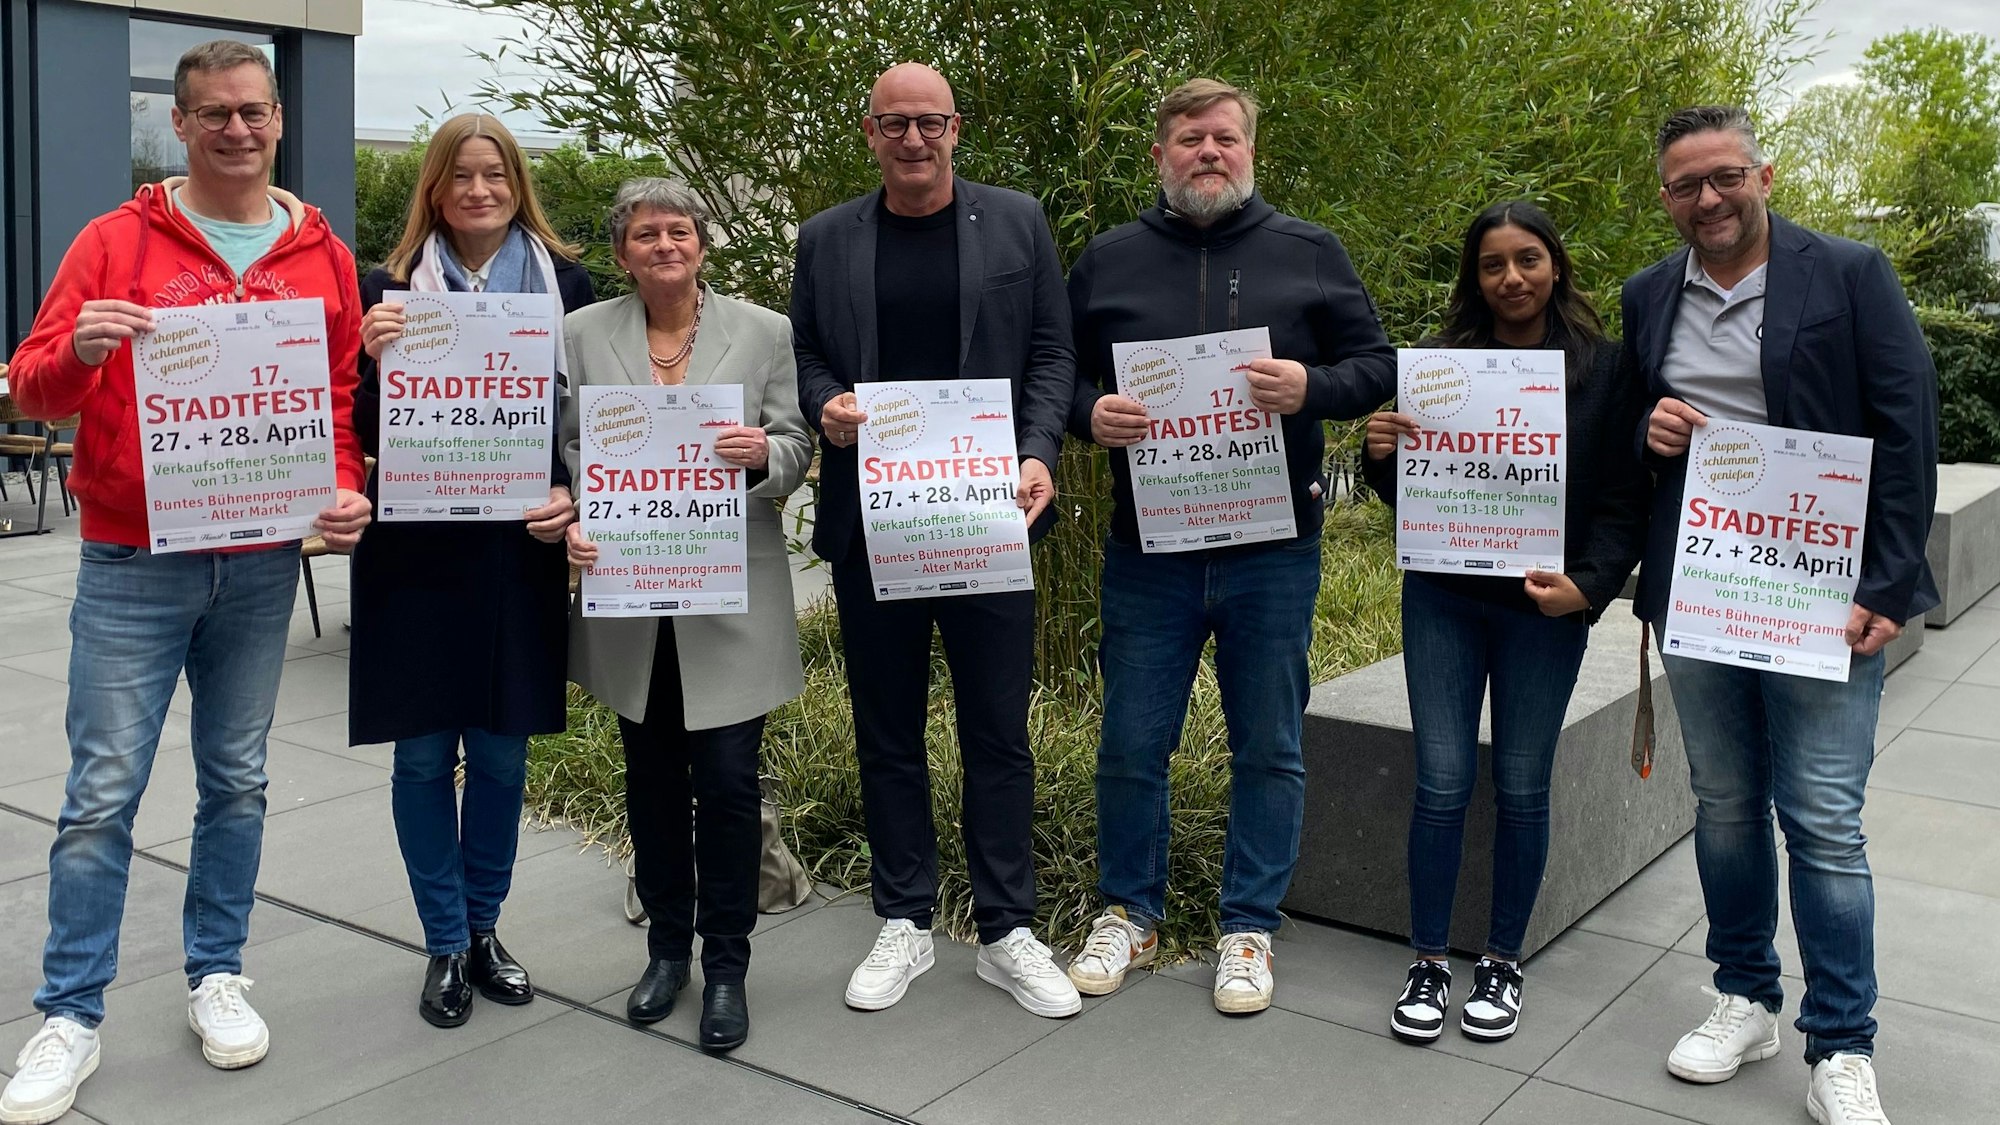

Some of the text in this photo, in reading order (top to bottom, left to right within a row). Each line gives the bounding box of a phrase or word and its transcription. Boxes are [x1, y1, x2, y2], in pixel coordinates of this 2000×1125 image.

[405, 310, 442, 324] hoppen
[152, 327, 198, 344] shoppen
[397, 322, 452, 338] chlemmen
[148, 339, 211, 361] schlemmen
[404, 337, 448, 354] genießen
[160, 355, 209, 376] genießen
[484, 352, 518, 371] 17.
[1130, 358, 1166, 373] shoppen
[250, 364, 289, 387] 17.
[1128, 368, 1177, 388] schlemmen
[1415, 367, 1454, 380] shoppen
[387, 370, 549, 399] STADTFEST
[1138, 382, 1176, 401] genießen
[1411, 379, 1464, 395] schlemmen
[144, 387, 325, 424] STADTFEST
[873, 399, 910, 412] shoppen
[1210, 387, 1243, 408] 17.
[1419, 393, 1462, 410] genießen
[388, 406, 547, 430] 27. + 28. April
[597, 404, 635, 417] shoppen
[870, 410, 919, 427] schlemmen
[1495, 407, 1529, 427] 17.
[593, 416, 645, 432] schlemmen
[878, 424, 917, 441] genießen
[1140, 408, 1273, 440] TADTFEST
[150, 418, 327, 452] 27. + 28. April
[387, 436, 544, 449] Verkaufsoffener Sonntag
[601, 430, 643, 448] genießen
[950, 435, 982, 454] 17.
[1404, 429, 1561, 456] STADTFEST
[421, 450, 512, 462] von 13-18 Uhr
[676, 443, 710, 463] 17.
[1135, 434, 1279, 465] 27. + 28. April
[1709, 441, 1750, 452] shoppen
[152, 451, 326, 476] Verkaufsoffener Sonntag
[863, 454, 1012, 485] STADTFEST
[1702, 455, 1759, 466] schlemmen
[191, 468, 291, 487] von 13-18 Uhr
[385, 470, 546, 483] Buntes Bühnenprogramm
[586, 463, 741, 492] STADTFEST
[1138, 464, 1281, 486] Verkaufsoffener Sonntag
[1405, 458, 1560, 486] 27. + 28. April
[1709, 469, 1755, 483] genießen
[434, 484, 466, 496] Alter
[469, 484, 505, 495] Markt
[868, 481, 1016, 509] 27. + 28. April
[1169, 480, 1251, 497] von 13-18 Uhr
[1405, 486, 1558, 507] Verkaufsoffener Sonntag
[153, 486, 331, 511] Buntes Bühnenprogramm
[1141, 495, 1286, 517] Buntes Bühnenprogramm
[1789, 492, 1824, 516] 17.
[210, 508, 245, 521] Alter
[249, 503, 289, 517] Markt
[588, 497, 740, 522] 27. + 28. April
[1187, 515, 1215, 527] Alter
[1218, 510, 1251, 523] Markt
[1436, 503, 1524, 516] von 13-18 Uhr
[870, 509, 1018, 532] Verkaufsoffener Sonntag
[1402, 519, 1559, 539] Buntes Bühnenprogramm
[1686, 497, 1859, 549] STADTFEST
[587, 529, 739, 542] Verkaufsoffener Sonntag
[904, 524, 988, 543] von 13-18 Uhr
[1449, 536, 1480, 548] Alter
[1483, 537, 1518, 550] Markt
[620, 543, 707, 556] von 13-18 Uhr
[874, 542, 1024, 564] Buntes Bühnenprogramm
[1685, 535, 1853, 578] 27. + 28. April
[586, 564, 741, 577] Buntes Bühnenprogramm
[922, 562, 950, 574] Alter
[953, 558, 988, 571] Markt
[634, 578, 664, 590] Alter
[668, 577, 702, 589] Markt
[1682, 565, 1849, 604] Verkaufsoffener Sonntag
[1674, 600, 1722, 618] Buntes
[1715, 588, 1811, 611] von 13-18 Uhr
[1724, 623, 1759, 639] Alter
[1761, 629, 1801, 647] Markt
